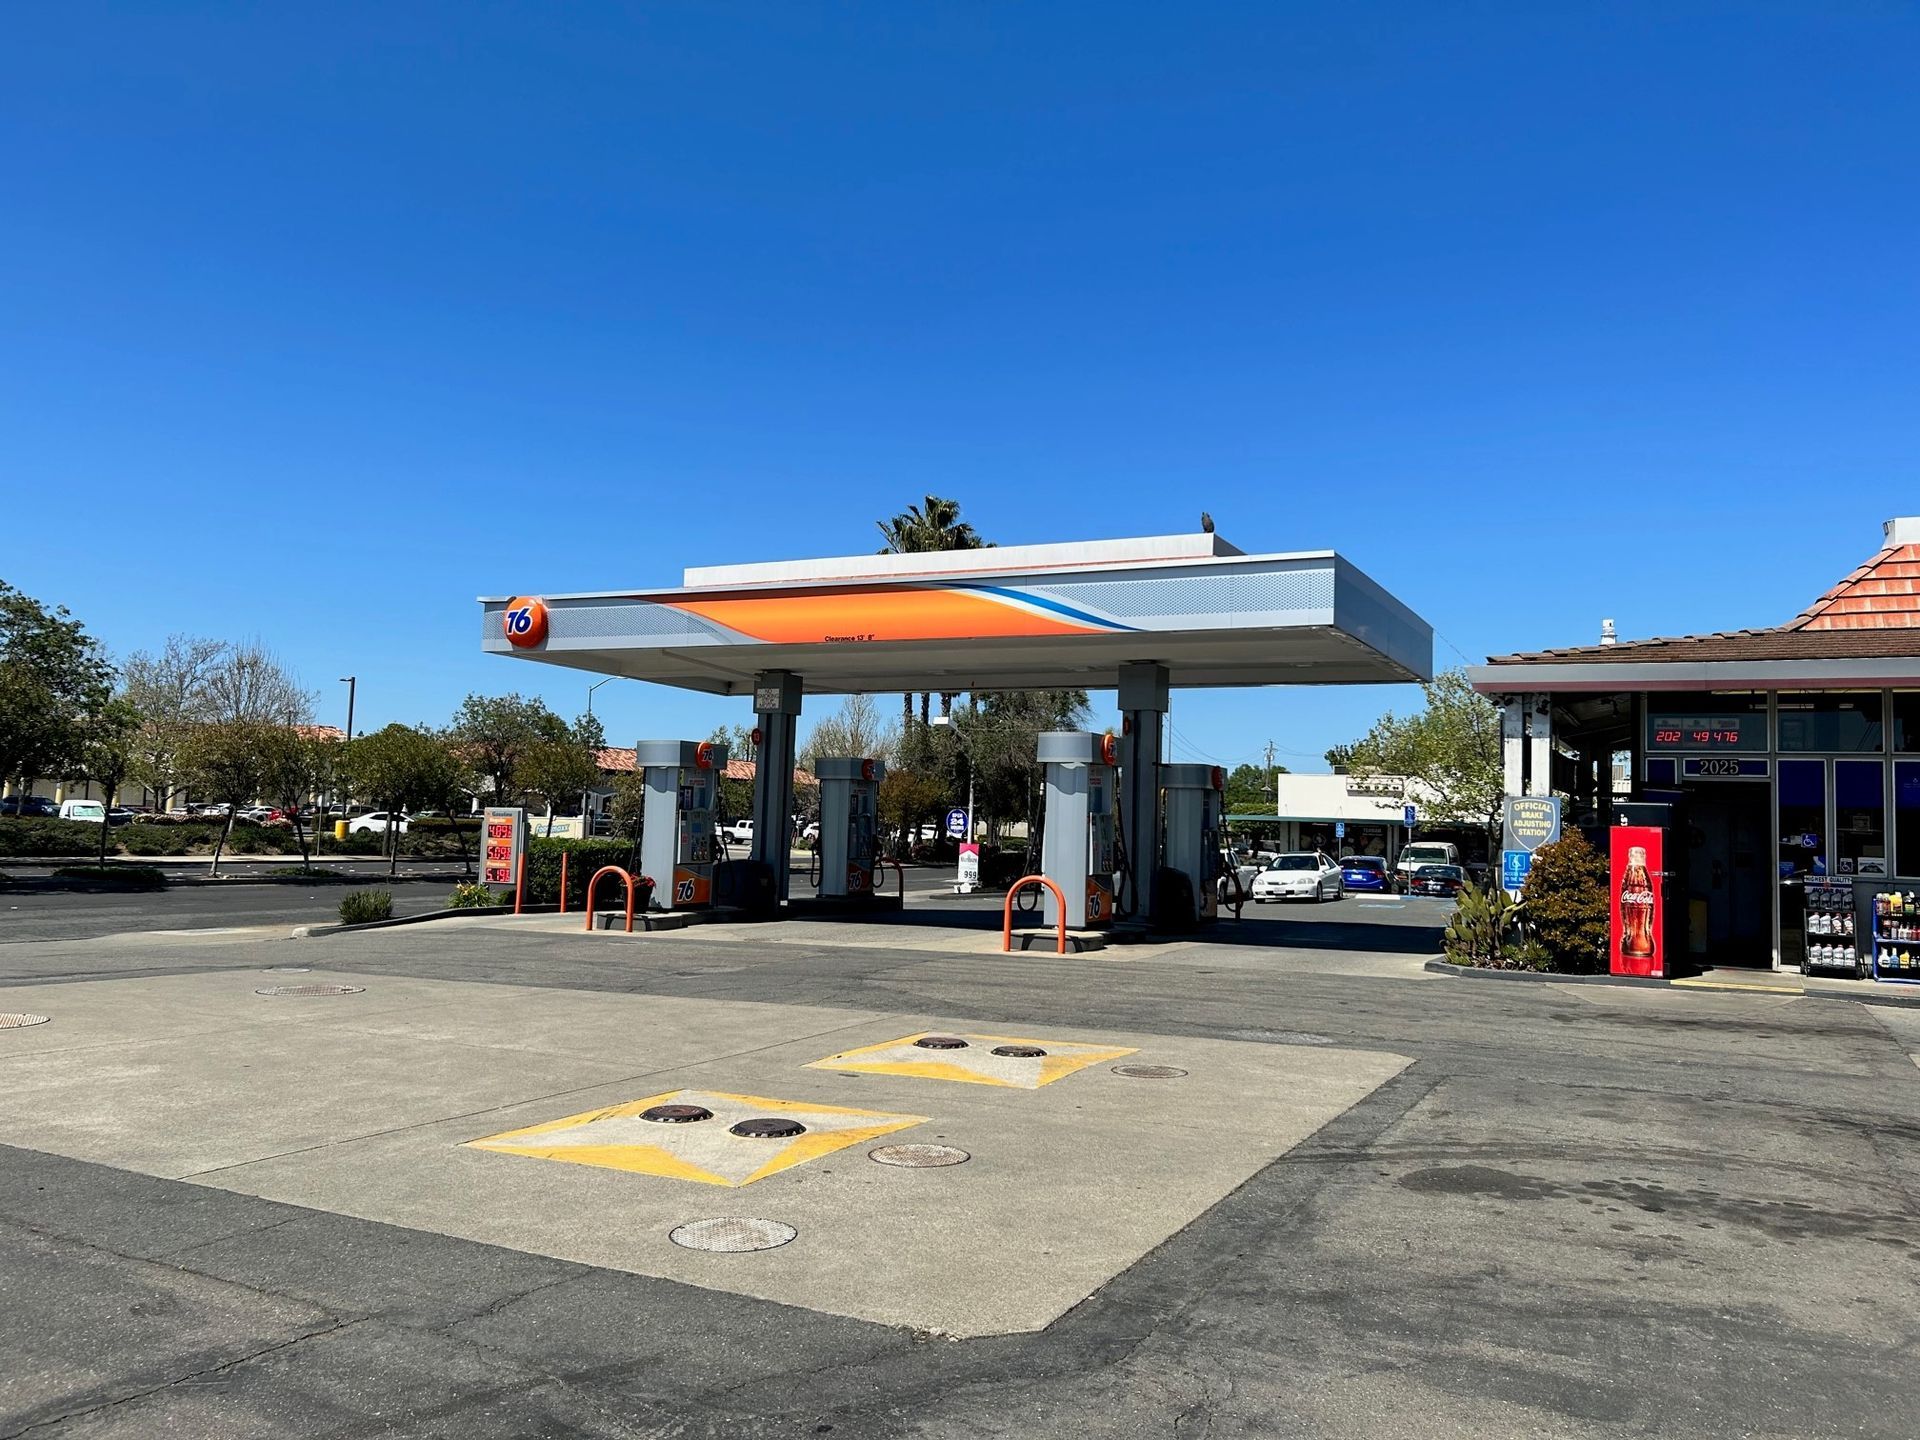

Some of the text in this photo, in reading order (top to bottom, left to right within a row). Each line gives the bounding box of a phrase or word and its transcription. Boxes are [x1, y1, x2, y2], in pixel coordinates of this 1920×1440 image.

[506, 606, 533, 635] 76
[1656, 731, 1681, 742] 202
[1693, 731, 1710, 742] 49
[1713, 731, 1738, 742] 476
[702, 749, 713, 761] 76
[1700, 760, 1739, 775] 2025
[1514, 802, 1551, 813] OFFICIAL
[1521, 811, 1544, 819] BRAKE
[535, 823, 570, 834] foomaxx
[1513, 820, 1551, 829] ADJUSTING
[677, 878, 695, 902] 76
[1088, 892, 1101, 918] 76
